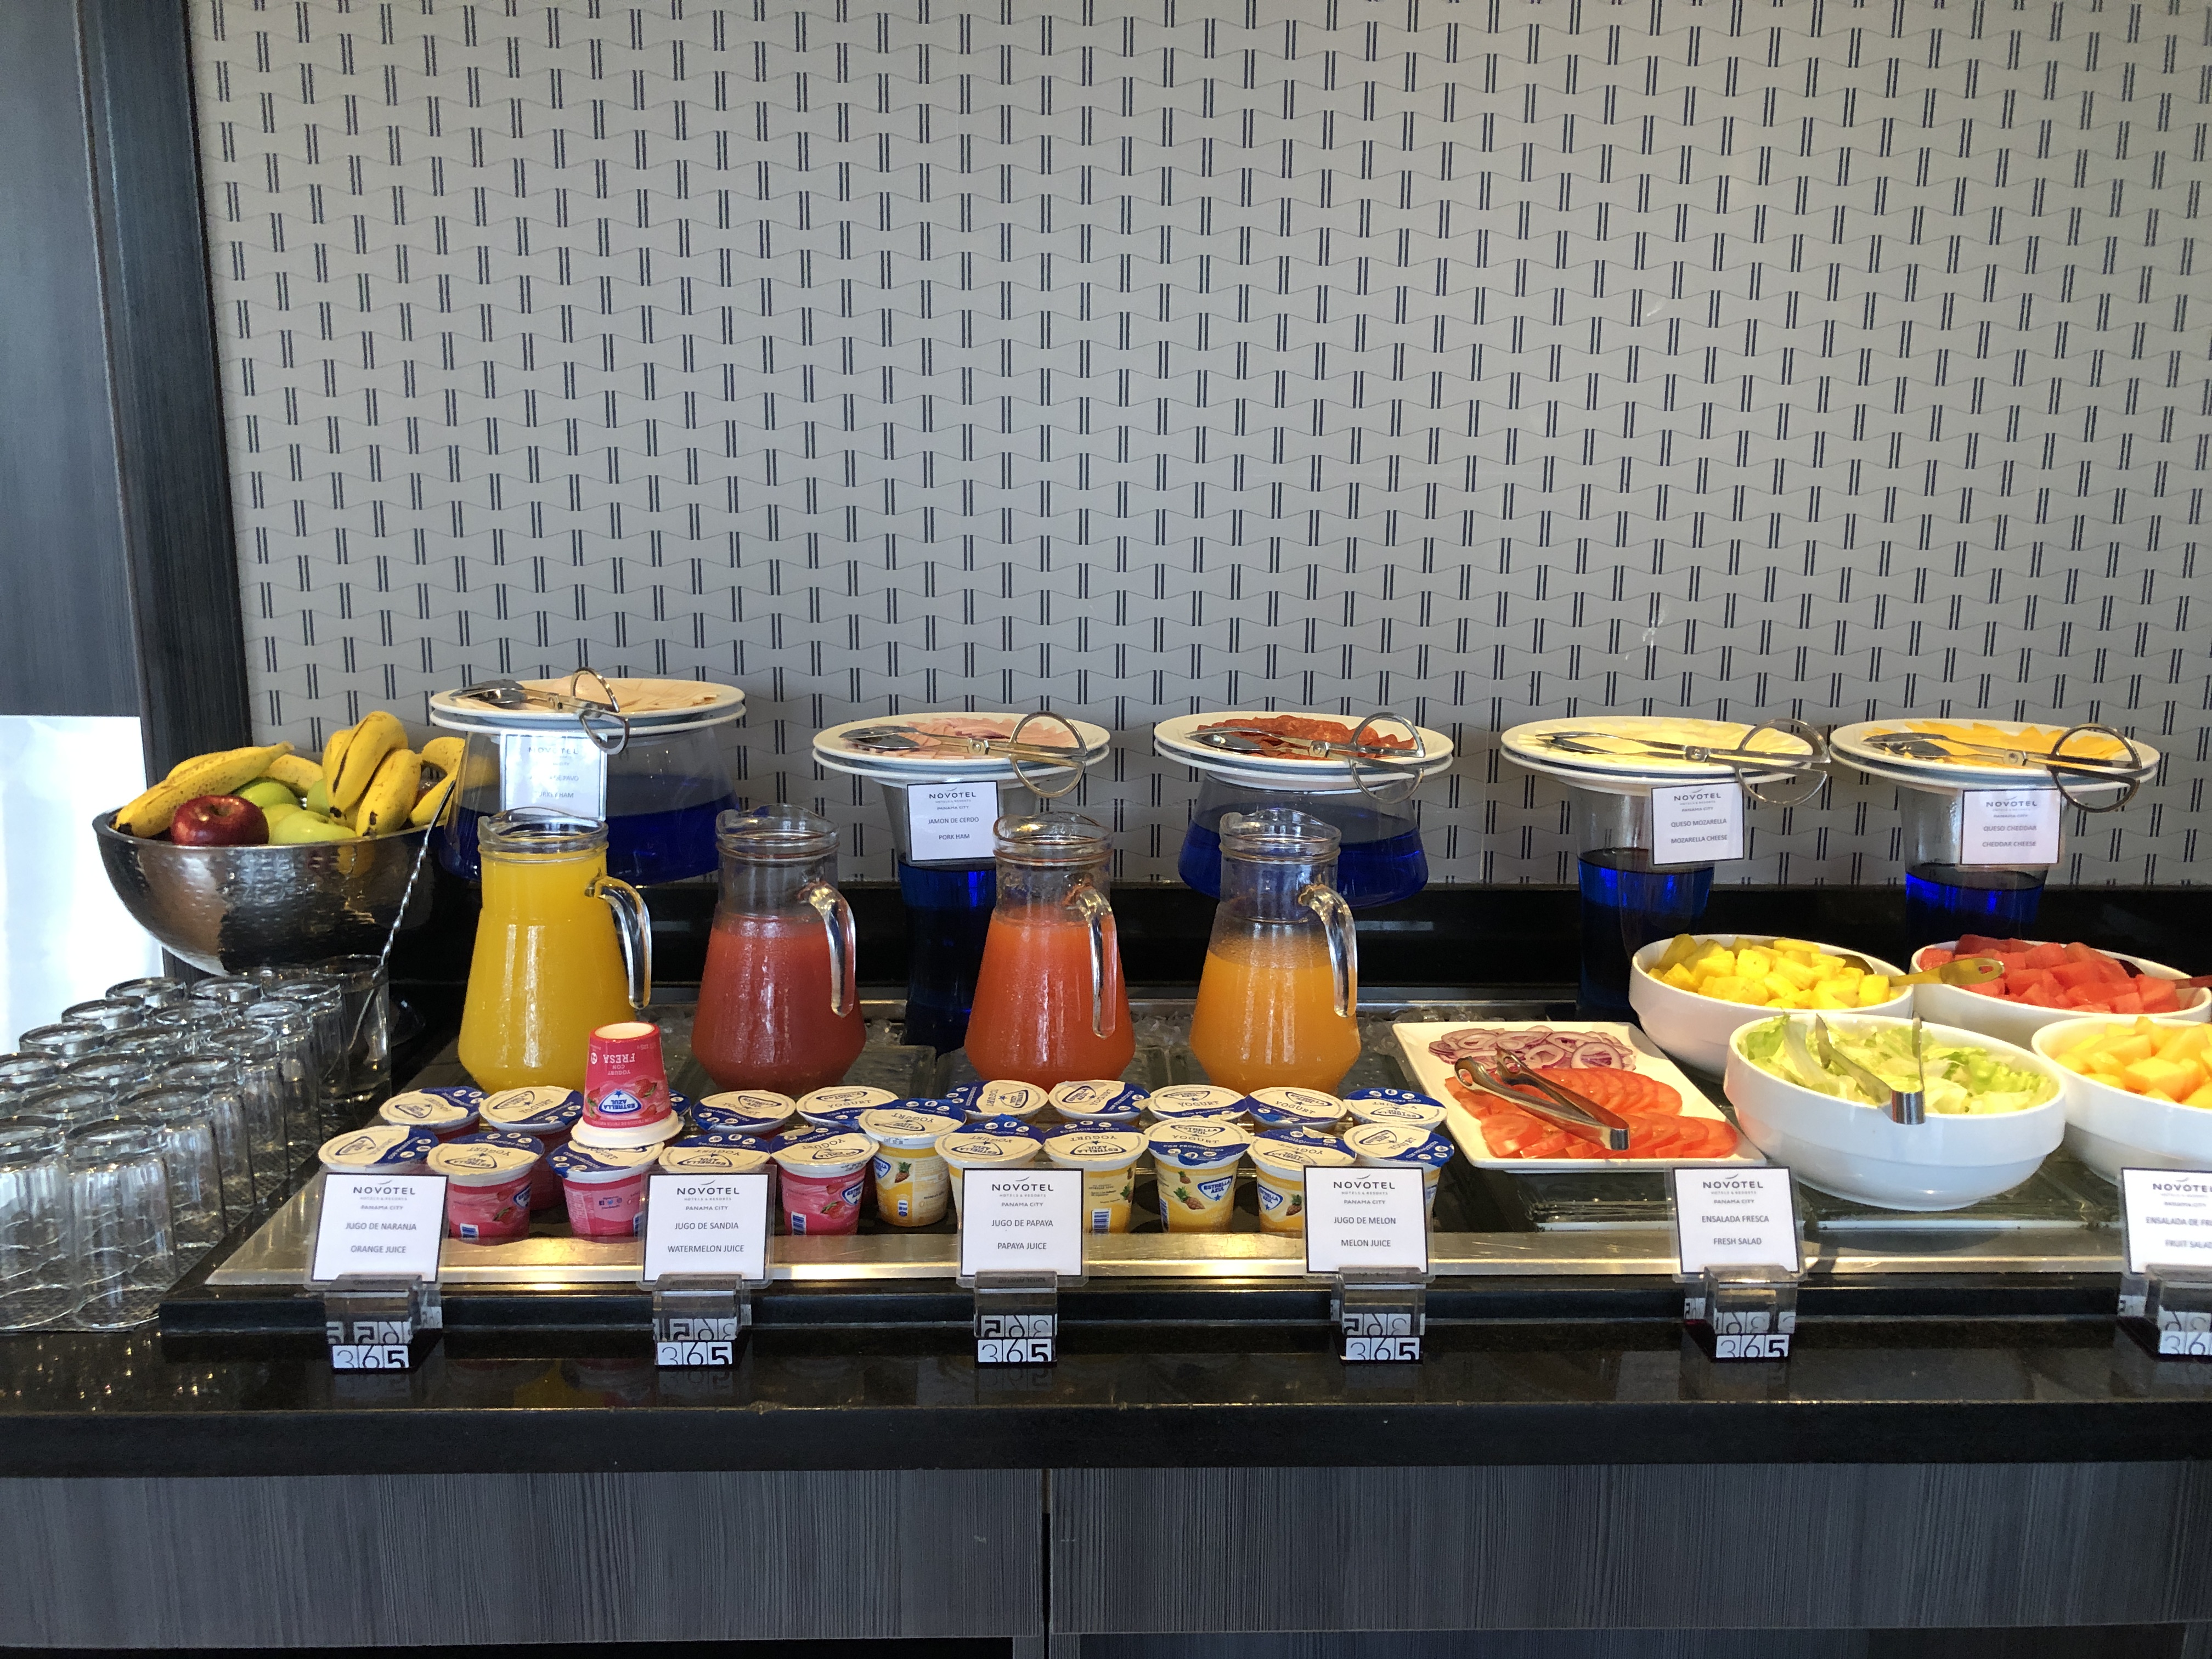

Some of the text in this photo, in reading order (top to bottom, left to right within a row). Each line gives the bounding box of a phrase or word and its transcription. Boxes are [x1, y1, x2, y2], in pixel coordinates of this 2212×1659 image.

[1674, 793, 1721, 801] NOVOTEL
[603, 1053, 635, 1063] FRESA
[986, 1088, 998, 1107] YOGURT
[1089, 1088, 1113, 1105] YOGURT
[518, 1099, 554, 1114] YOGURT
[723, 1102, 761, 1115] YOGURT
[827, 1099, 871, 1108] YOGURT
[1275, 1101, 1316, 1114] YOGURT
[890, 1113, 934, 1122] YOGURT
[802, 1138, 845, 1150] YOGURT
[1172, 1135, 1219, 1144] YOGURT
[466, 1147, 511, 1156] YOGURT
[353, 1186, 416, 1195] NOVOTEL
[1204, 1180, 1230, 1190] ESTRELLA
[2146, 1216, 2186, 1224] ENSALADA
[981, 1339, 1048, 1362] 365
[1350, 1338, 1417, 1360] 365
[1720, 1335, 1785, 1357] 365
[337, 1345, 405, 1368] 365
[662, 1342, 730, 1364] 365
